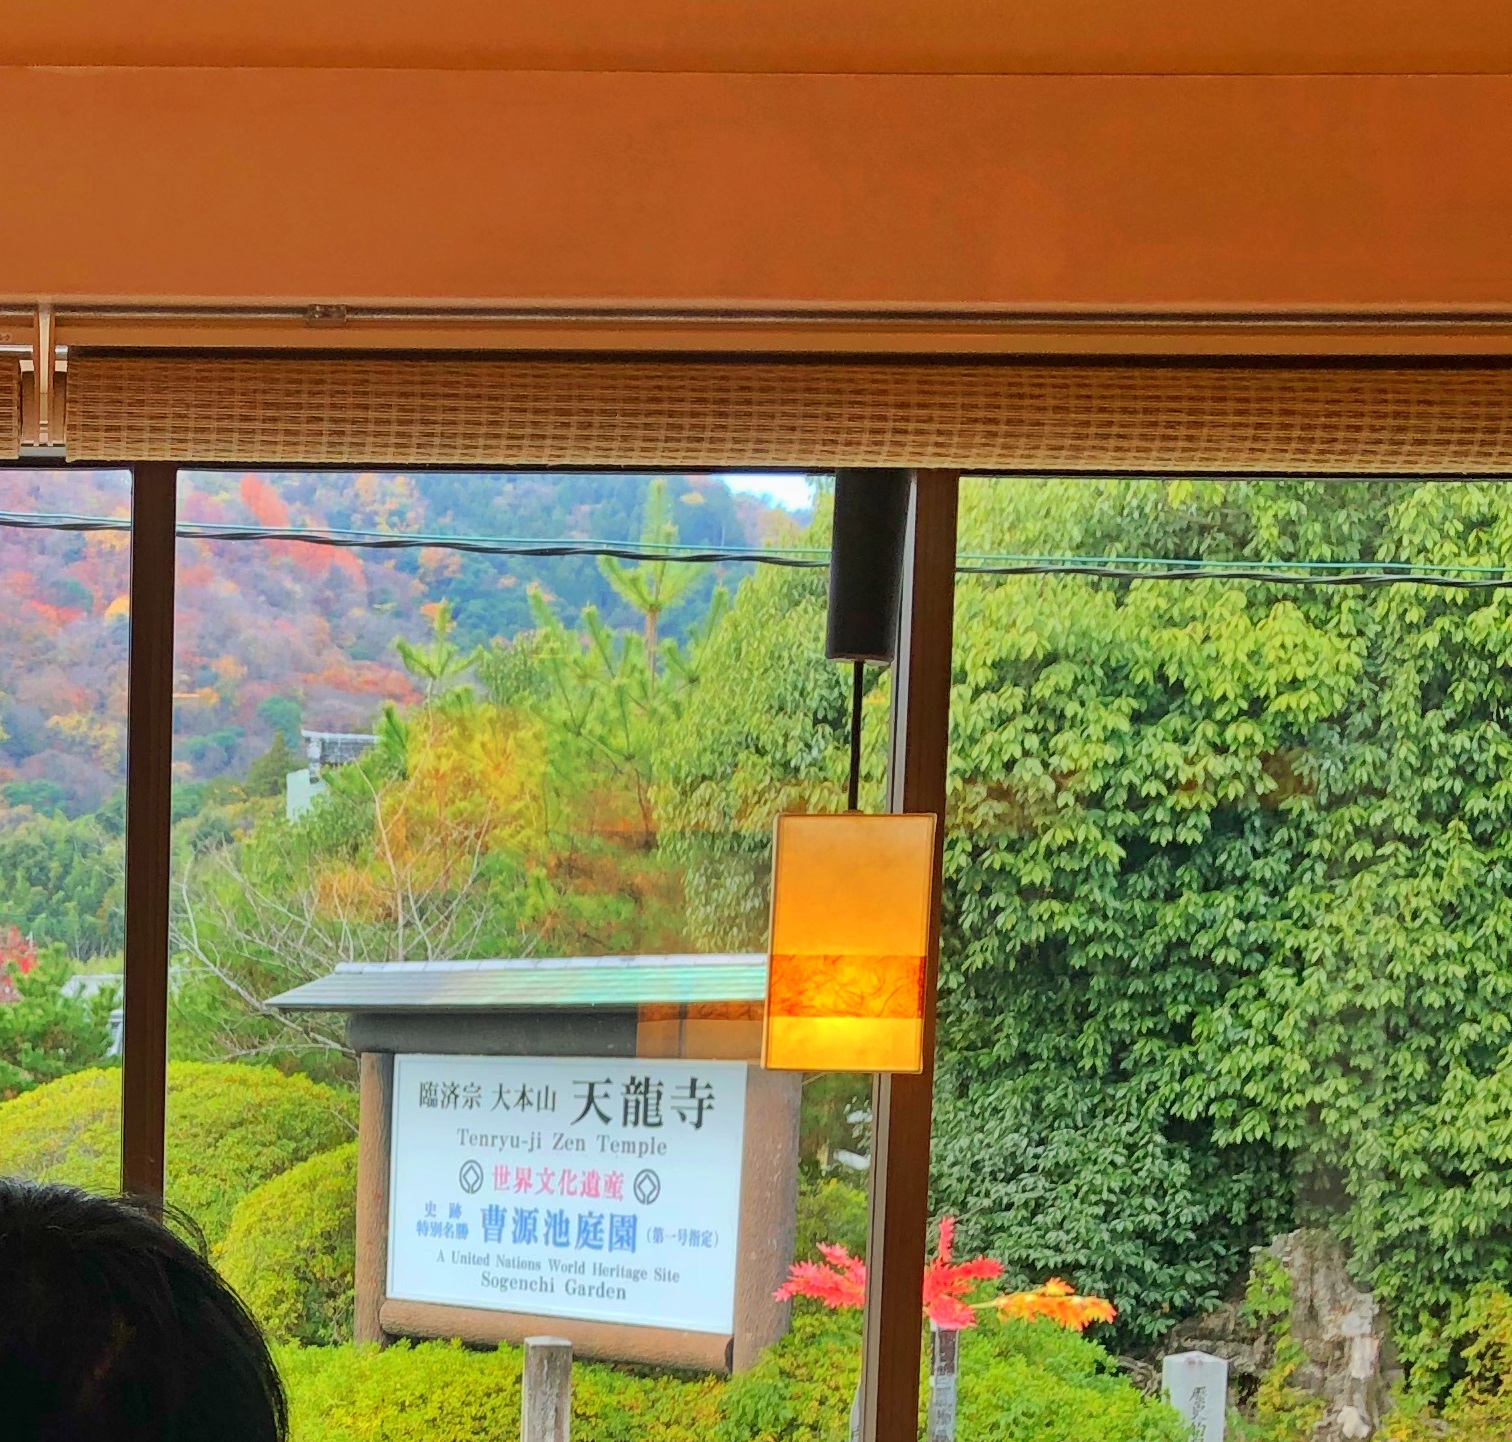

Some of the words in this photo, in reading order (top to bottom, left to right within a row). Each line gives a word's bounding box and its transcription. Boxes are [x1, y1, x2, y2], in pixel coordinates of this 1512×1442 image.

[491, 1081, 557, 1114] 大本山
[570, 1074, 716, 1130] 天龍寺
[457, 1127, 542, 1153] Tenryu-ji
[552, 1133, 586, 1153] Zen
[596, 1134, 668, 1159] Temple
[491, 1164, 625, 1202] 世界文化遺産
[479, 1204, 638, 1255] 曹源池庭園
[436, 1250, 445, 1263] A
[451, 1250, 490, 1267] United
[495, 1254, 542, 1272] Nations
[548, 1258, 586, 1276] World
[592, 1261, 648, 1284] Heritage
[653, 1265, 681, 1283] Site
[480, 1271, 555, 1295] Sogenchi
[564, 1278, 627, 1300] Garden
